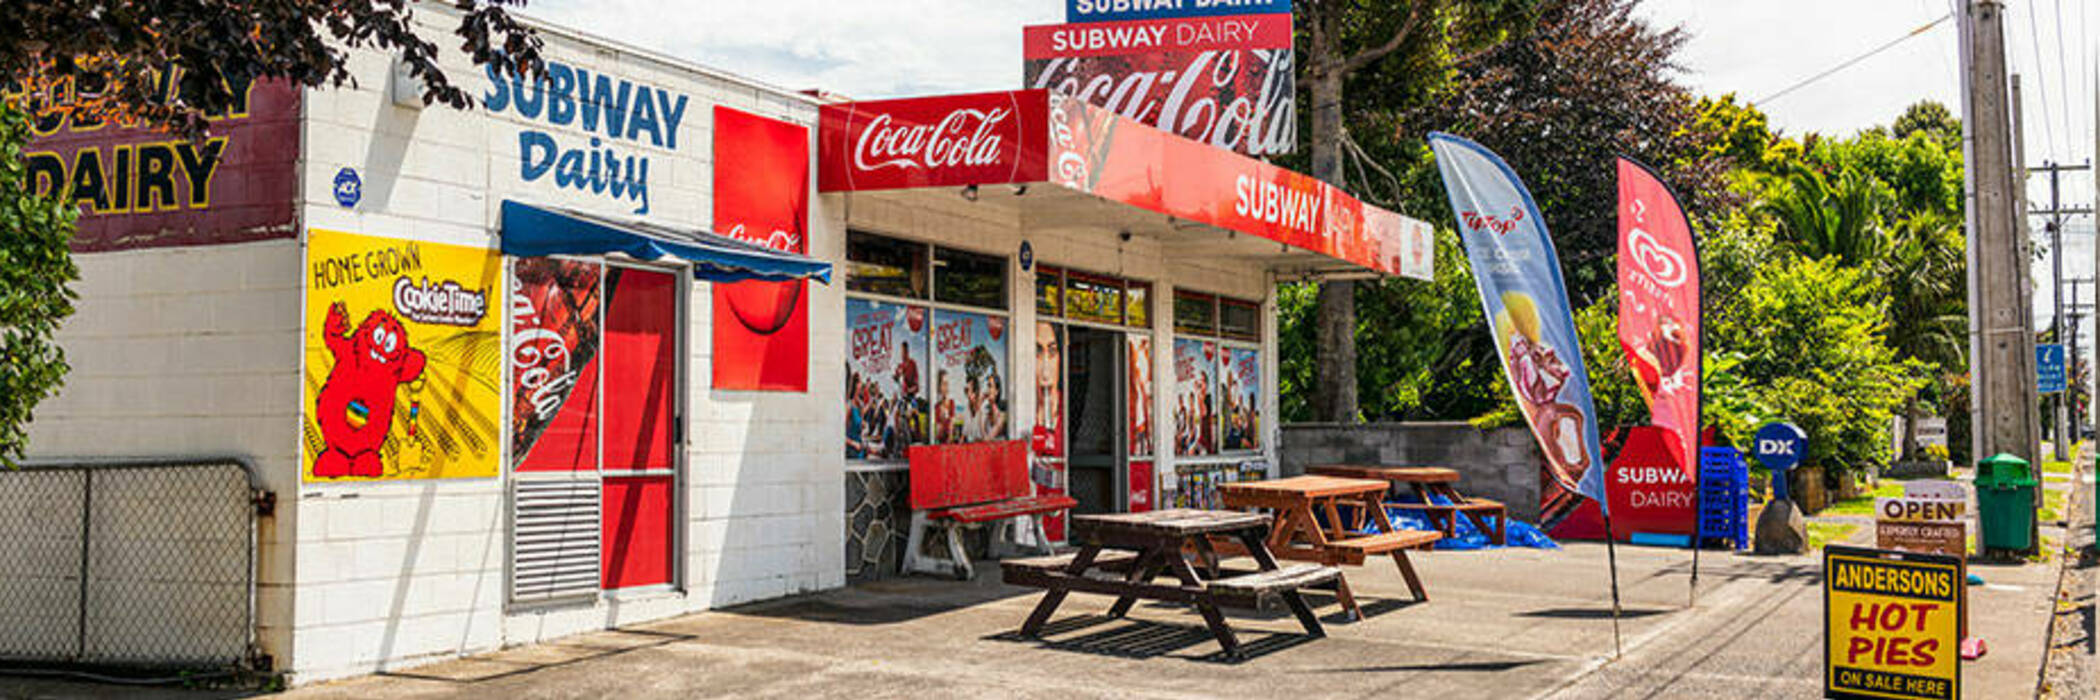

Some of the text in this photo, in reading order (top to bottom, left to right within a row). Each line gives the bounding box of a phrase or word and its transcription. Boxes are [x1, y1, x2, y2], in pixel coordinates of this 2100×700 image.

[1053, 21, 1259, 51] SUBWAY DAIRY
[485, 57, 689, 150] SUBWAY
[24, 135, 229, 214] DAIRY
[519, 131, 649, 215] Dairy
[1235, 174, 1321, 234] SUBWAY
[313, 241, 422, 290] HOME GROWN
[1760, 439, 1795, 455] DX
[1630, 490, 1694, 508] DAIRY
[1884, 500, 1956, 520] OPEN
[1836, 563, 1951, 597] ANDERSONS
[1850, 602, 1940, 631] HOT
[1848, 636, 1940, 668] PIES
[1840, 671, 1946, 696] ON SALE HERE
